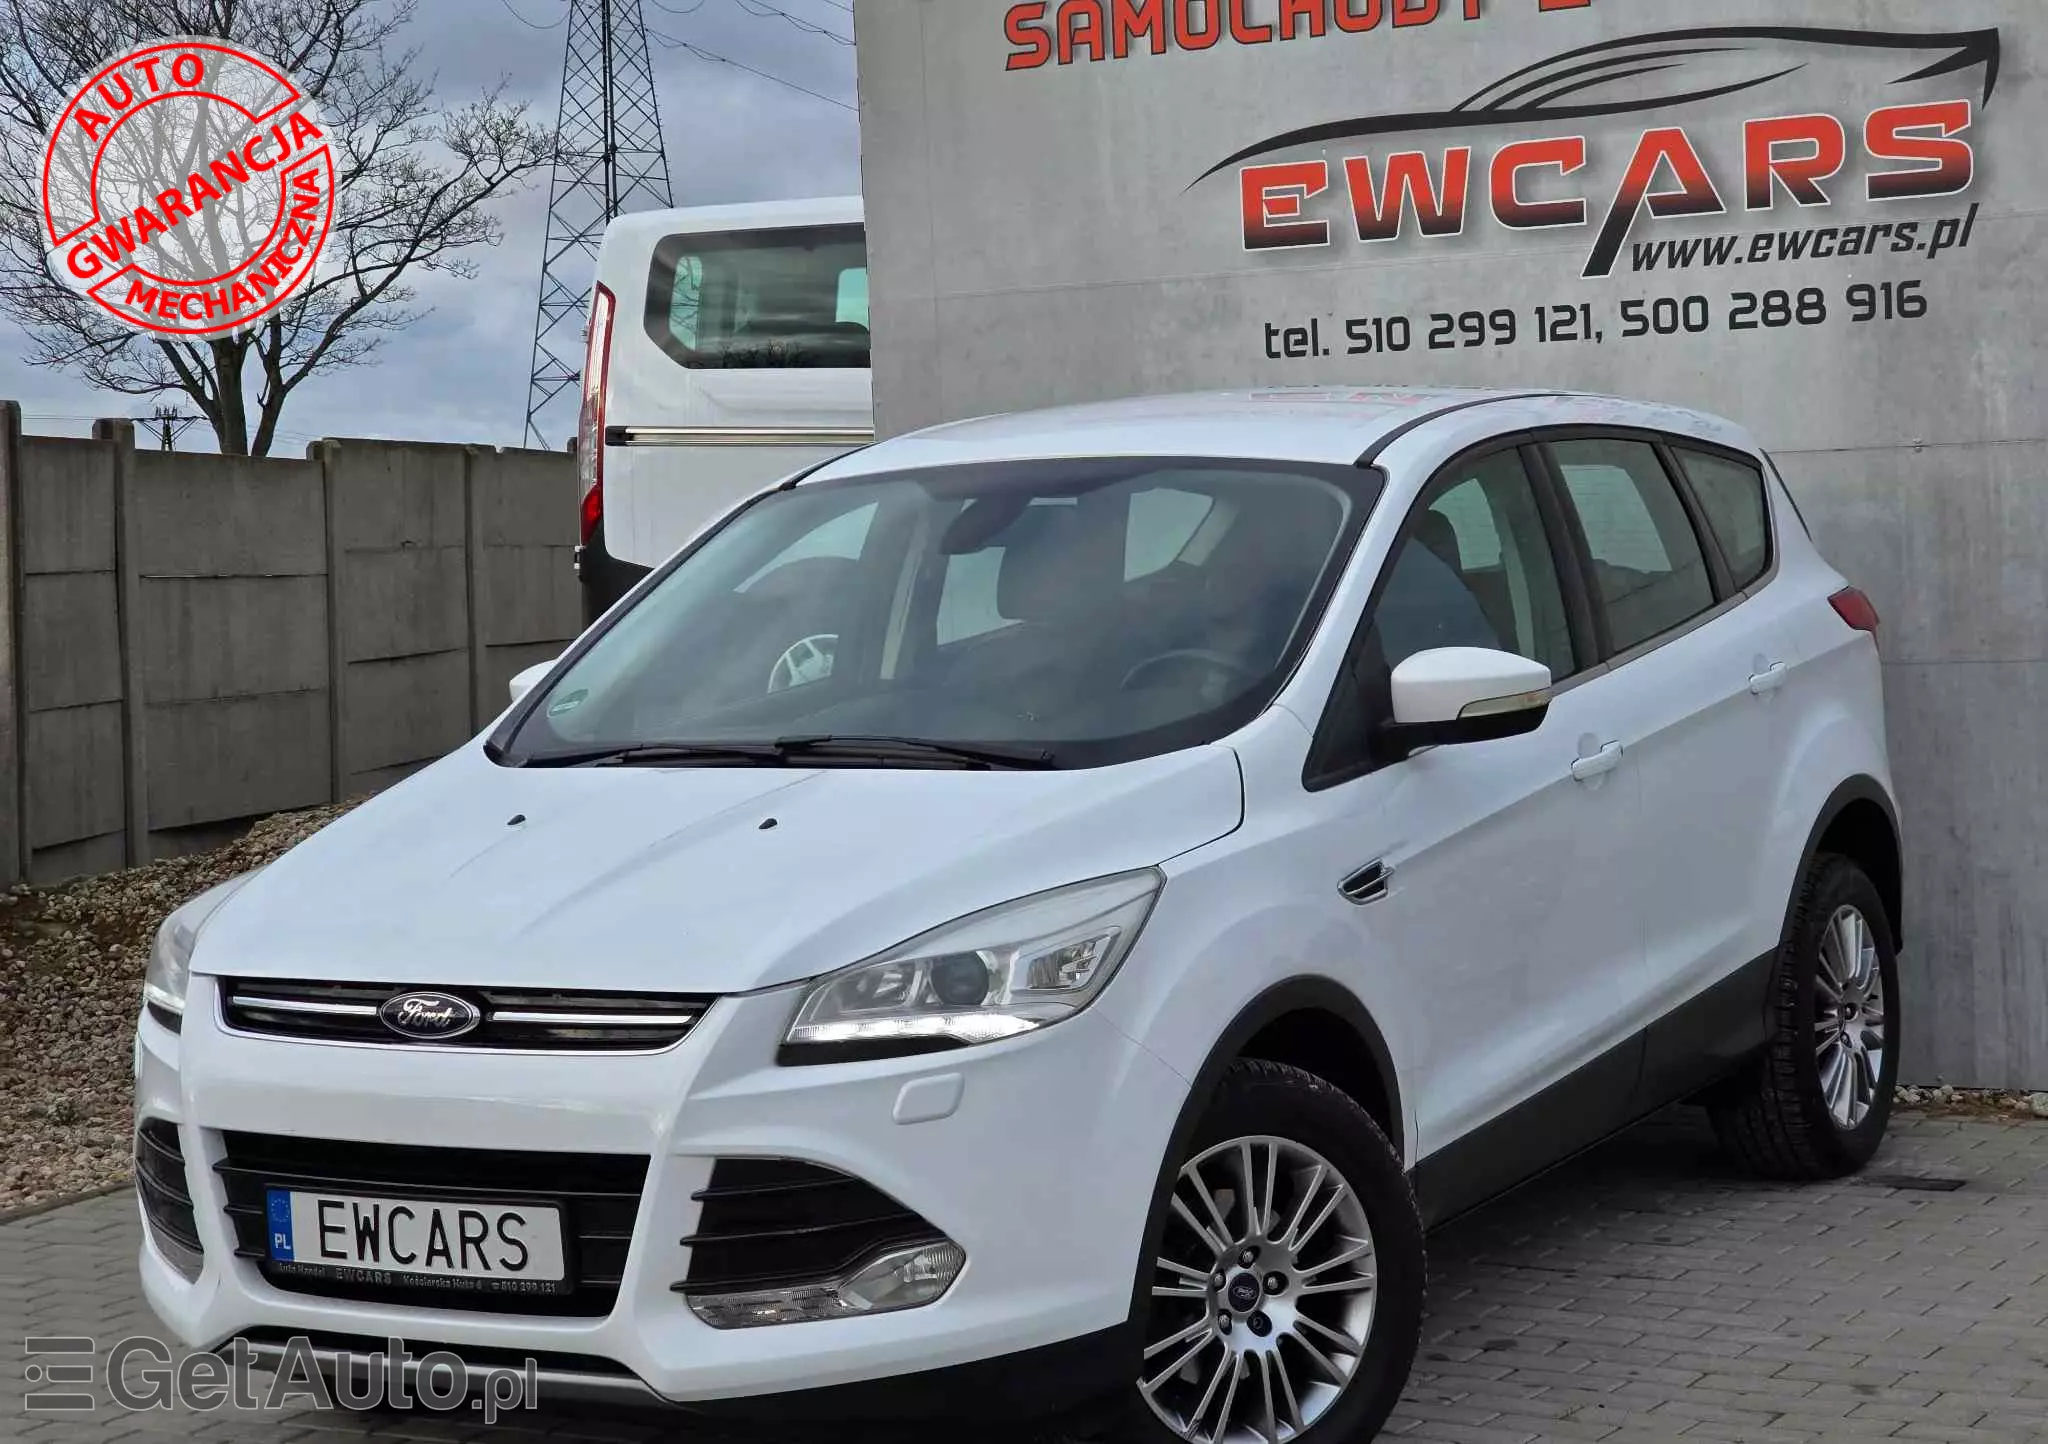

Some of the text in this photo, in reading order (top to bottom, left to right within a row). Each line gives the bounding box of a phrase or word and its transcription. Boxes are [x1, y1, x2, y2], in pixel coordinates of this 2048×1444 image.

[1240, 99, 1974, 280] EWCARS
[1631, 202, 1980, 272] www.ewcars.pl
[1264, 280, 1928, 359] tel. 510 299 121, 500 288 916
[274, 1232, 292, 1250] PL
[317, 1199, 529, 1272] EWCARS
[336, 1267, 392, 1285] EWCARS
